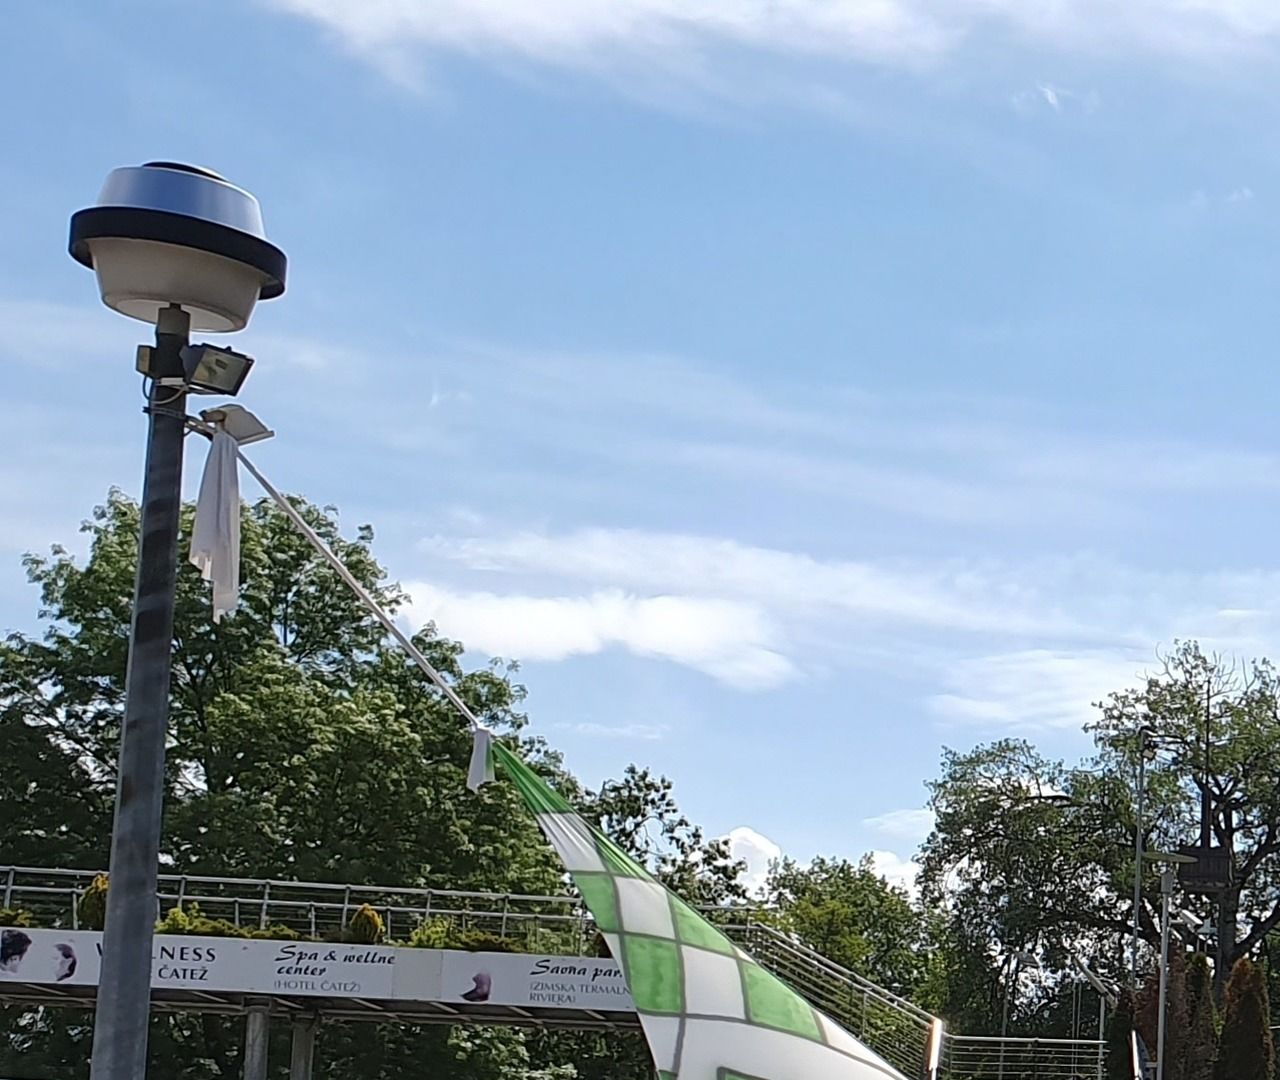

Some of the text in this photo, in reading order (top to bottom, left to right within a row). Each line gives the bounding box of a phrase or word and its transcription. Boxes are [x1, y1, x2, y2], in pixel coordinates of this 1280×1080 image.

[274, 944, 319, 966] Spa
[323, 950, 338, 962] &
[158, 963, 209, 981] ČATEŽ
[276, 964, 327, 977] center
[592, 967, 623, 982] par
